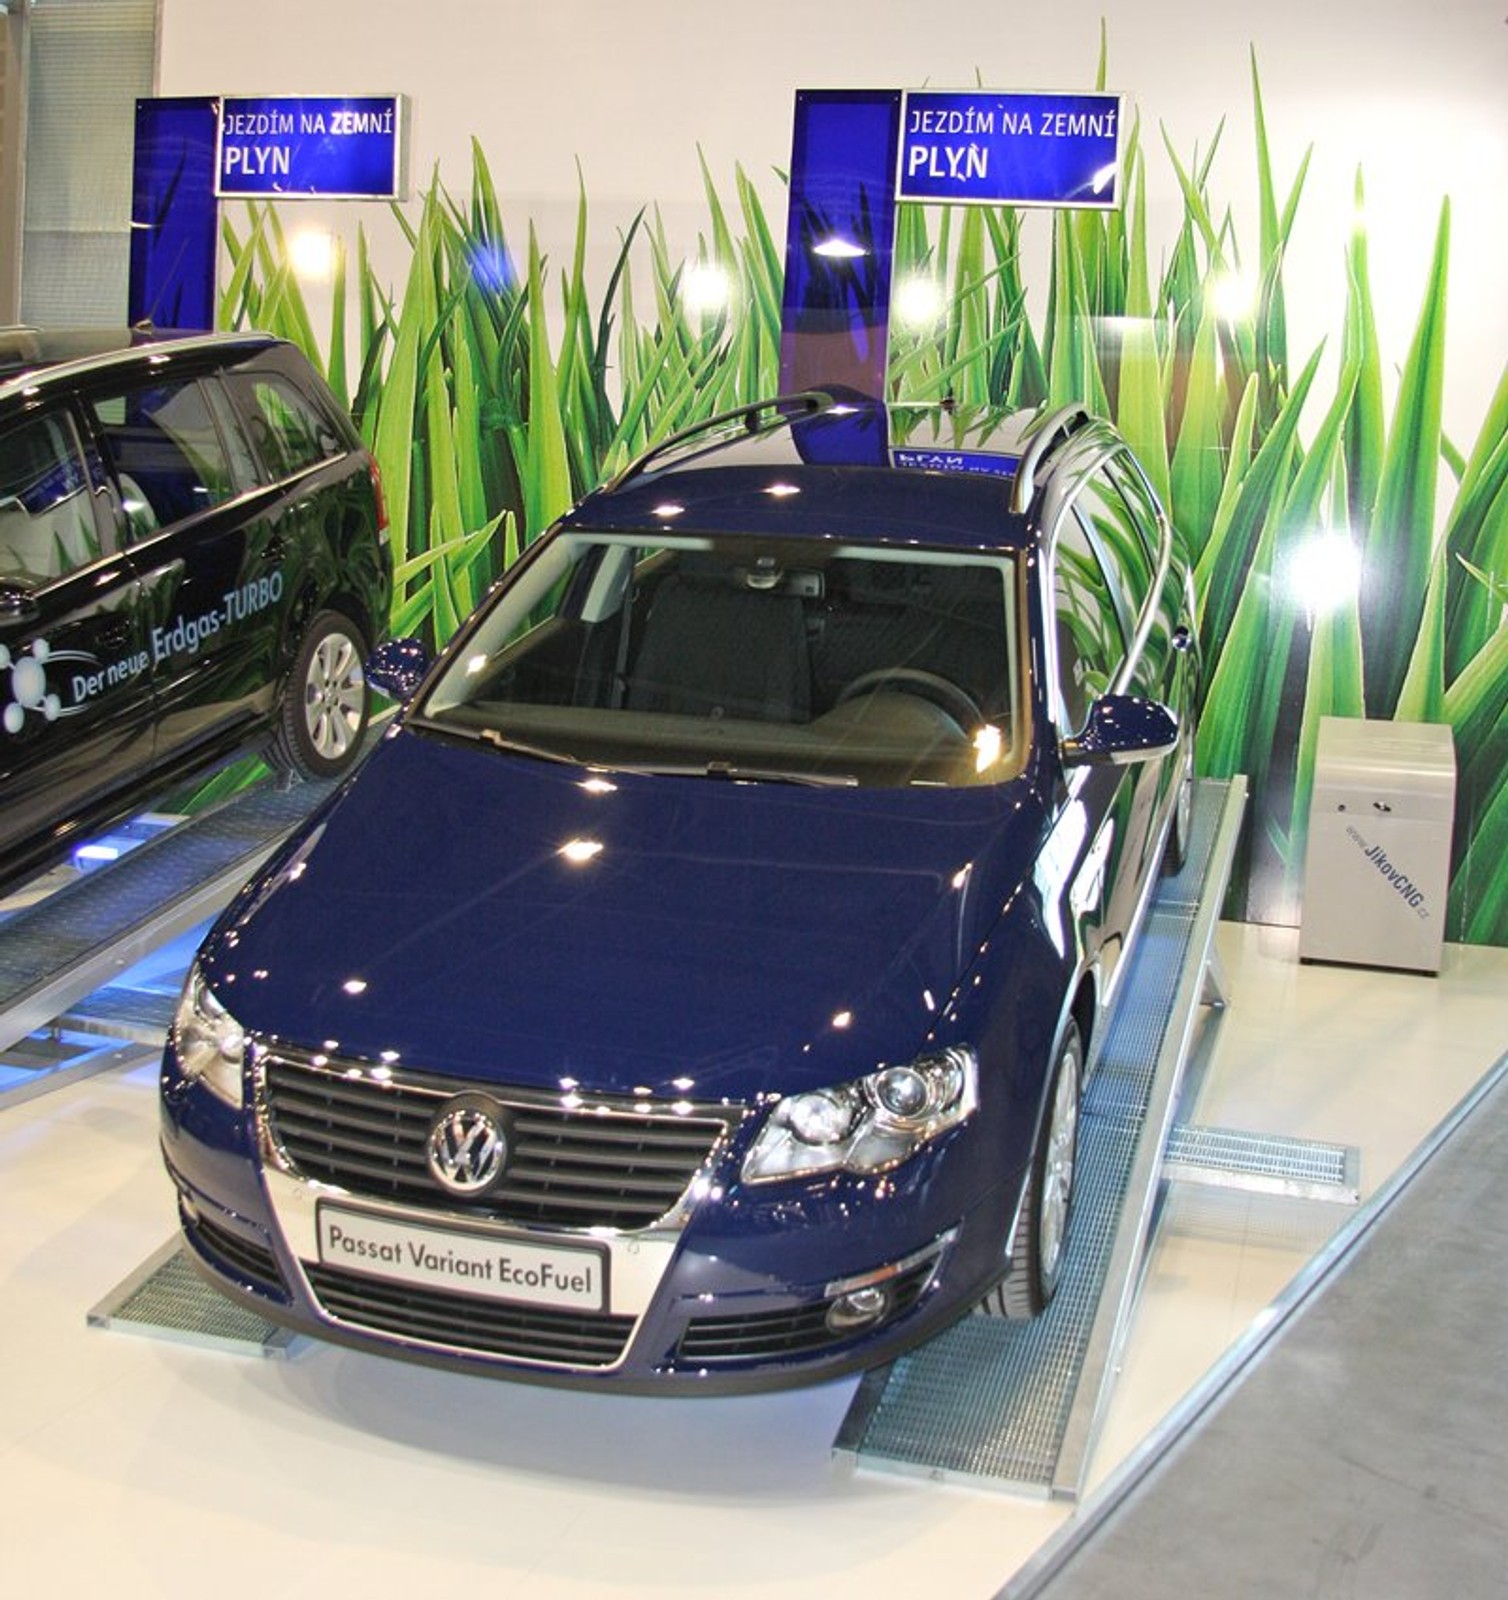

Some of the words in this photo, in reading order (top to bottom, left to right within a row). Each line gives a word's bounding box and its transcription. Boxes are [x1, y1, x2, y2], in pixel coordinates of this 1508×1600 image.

[225, 109, 294, 135] JEZDÍM
[301, 114, 326, 134] NA
[330, 108, 393, 134] ZEMNÍ
[910, 106, 994, 134] JEZDÍM
[1002, 112, 1033, 136] NA
[1040, 109, 1116, 137] ZEMNÍ
[224, 146, 291, 175] PLYN
[908, 145, 988, 179] PLYN
[72, 671, 104, 702] Der
[107, 651, 150, 684] neue
[152, 570, 283, 662] Erdgas-TURBO
[329, 1225, 402, 1265] Passat
[407, 1241, 492, 1281] Variant
[500, 1258, 592, 1293] EcoFuel
